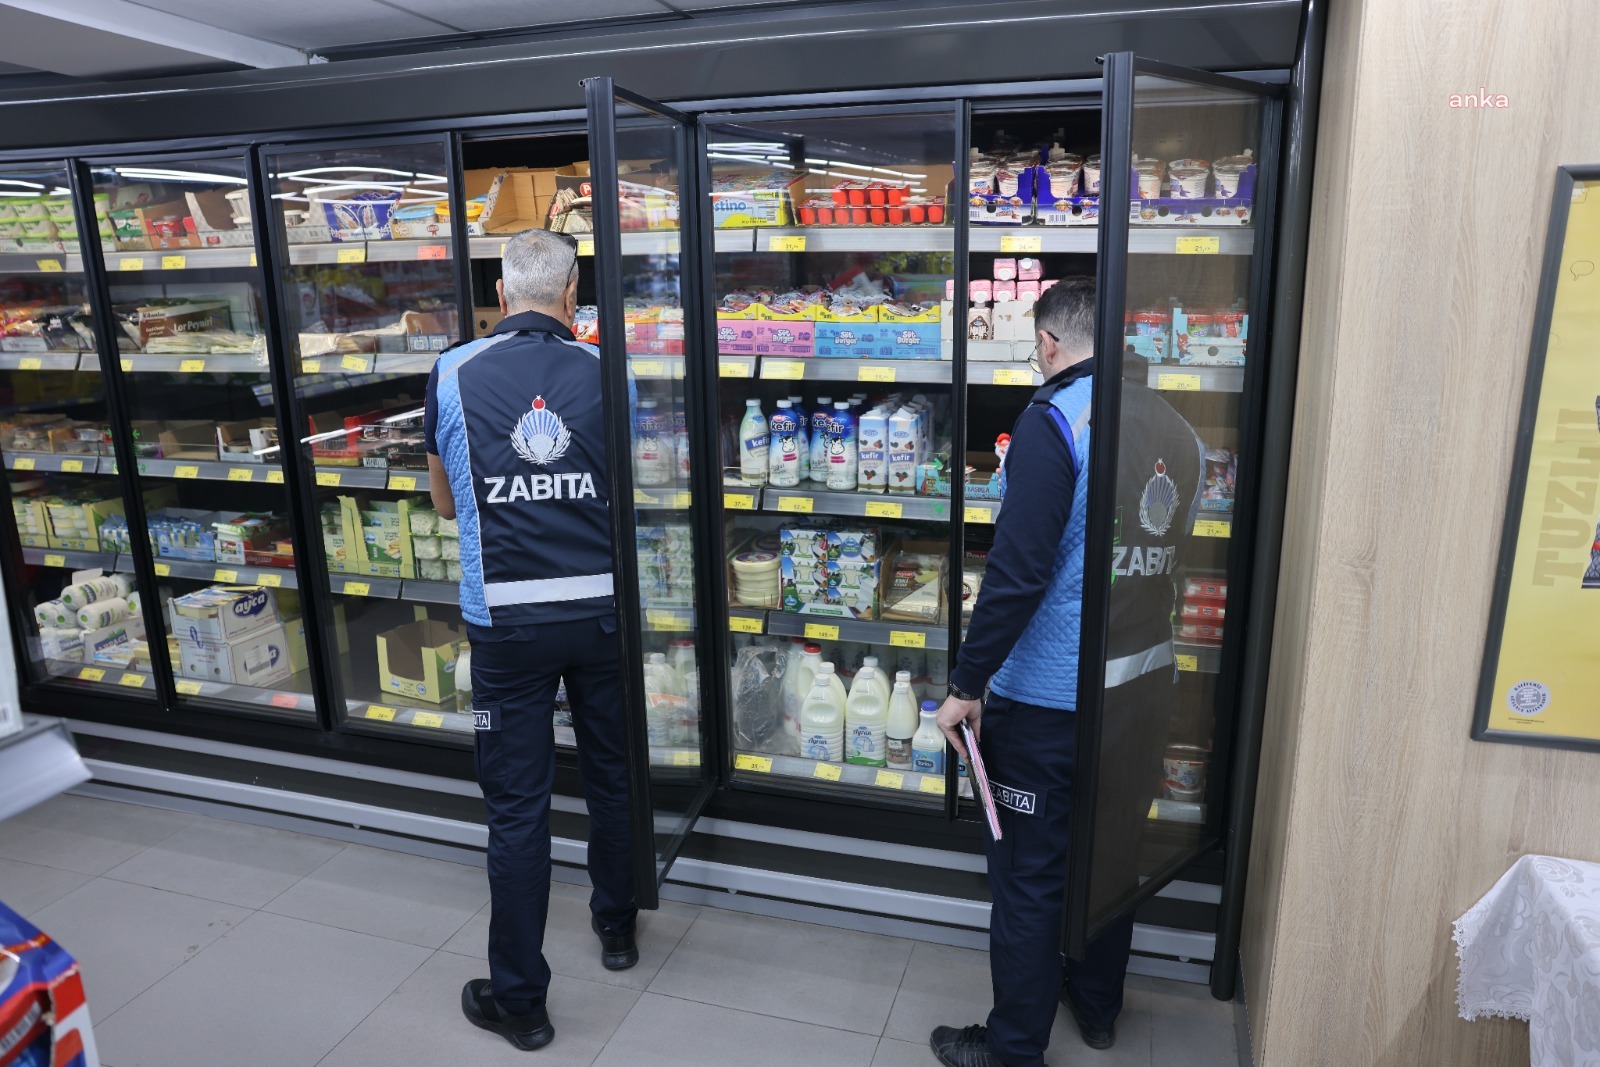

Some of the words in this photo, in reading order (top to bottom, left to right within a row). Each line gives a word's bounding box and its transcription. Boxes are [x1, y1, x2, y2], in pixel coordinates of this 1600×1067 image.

[714, 199, 747, 212] stino
[173, 323, 187, 332] Lor
[187, 316, 213, 331] Peyniri
[771, 420, 797, 431] kefir
[826, 422, 845, 434] efir
[891, 454, 910, 462] kefir
[483, 472, 597, 504] ZABITA
[1111, 545, 1178, 577] ZABIT
